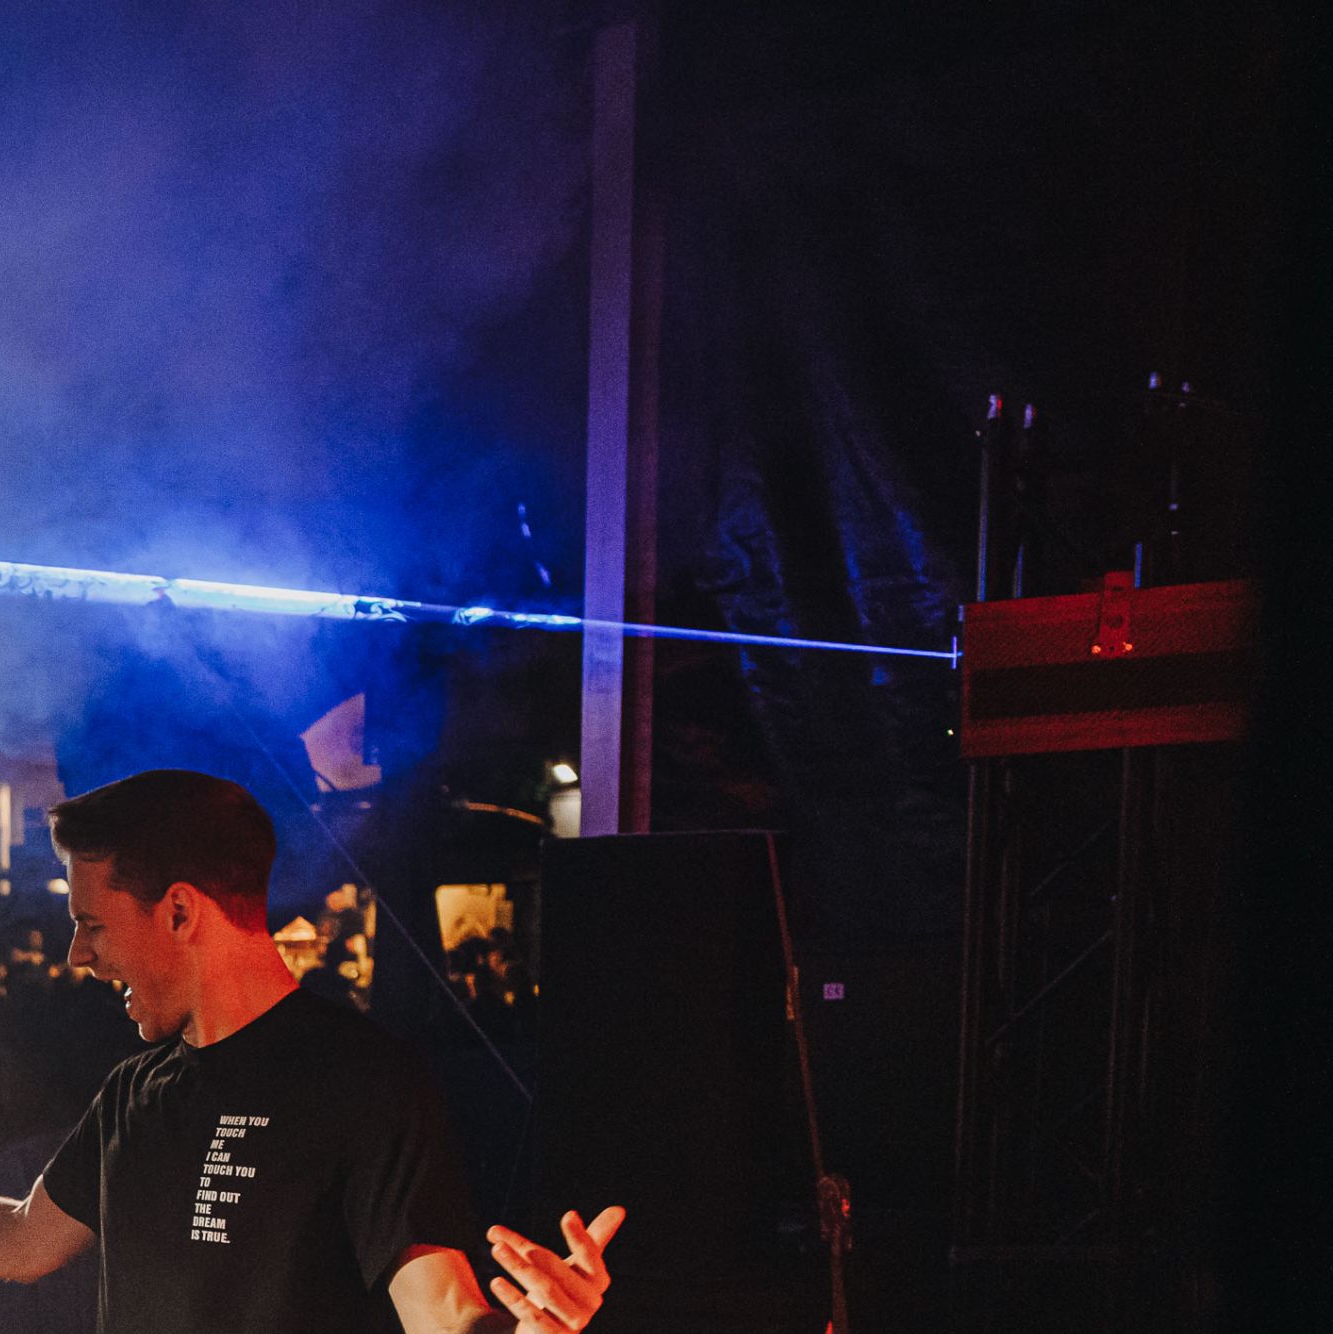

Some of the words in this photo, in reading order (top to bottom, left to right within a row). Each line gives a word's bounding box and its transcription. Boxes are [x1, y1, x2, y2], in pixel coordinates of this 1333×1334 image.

[219, 1115, 246, 1126] WHEN
[248, 1116, 270, 1127] YOU
[215, 1127, 246, 1138] TOUCH
[210, 1139, 225, 1150] ME
[211, 1152, 231, 1163] CAN
[203, 1164, 233, 1176] TOUCH
[235, 1166, 256, 1178] YOU
[200, 1177, 211, 1187] TO
[196, 1190, 218, 1202] FIND
[219, 1192, 241, 1204] OUT
[195, 1203, 212, 1215] THE
[193, 1216, 226, 1229] DREAM
[191, 1229, 200, 1240] IS
[202, 1230, 231, 1244] TRUE.
